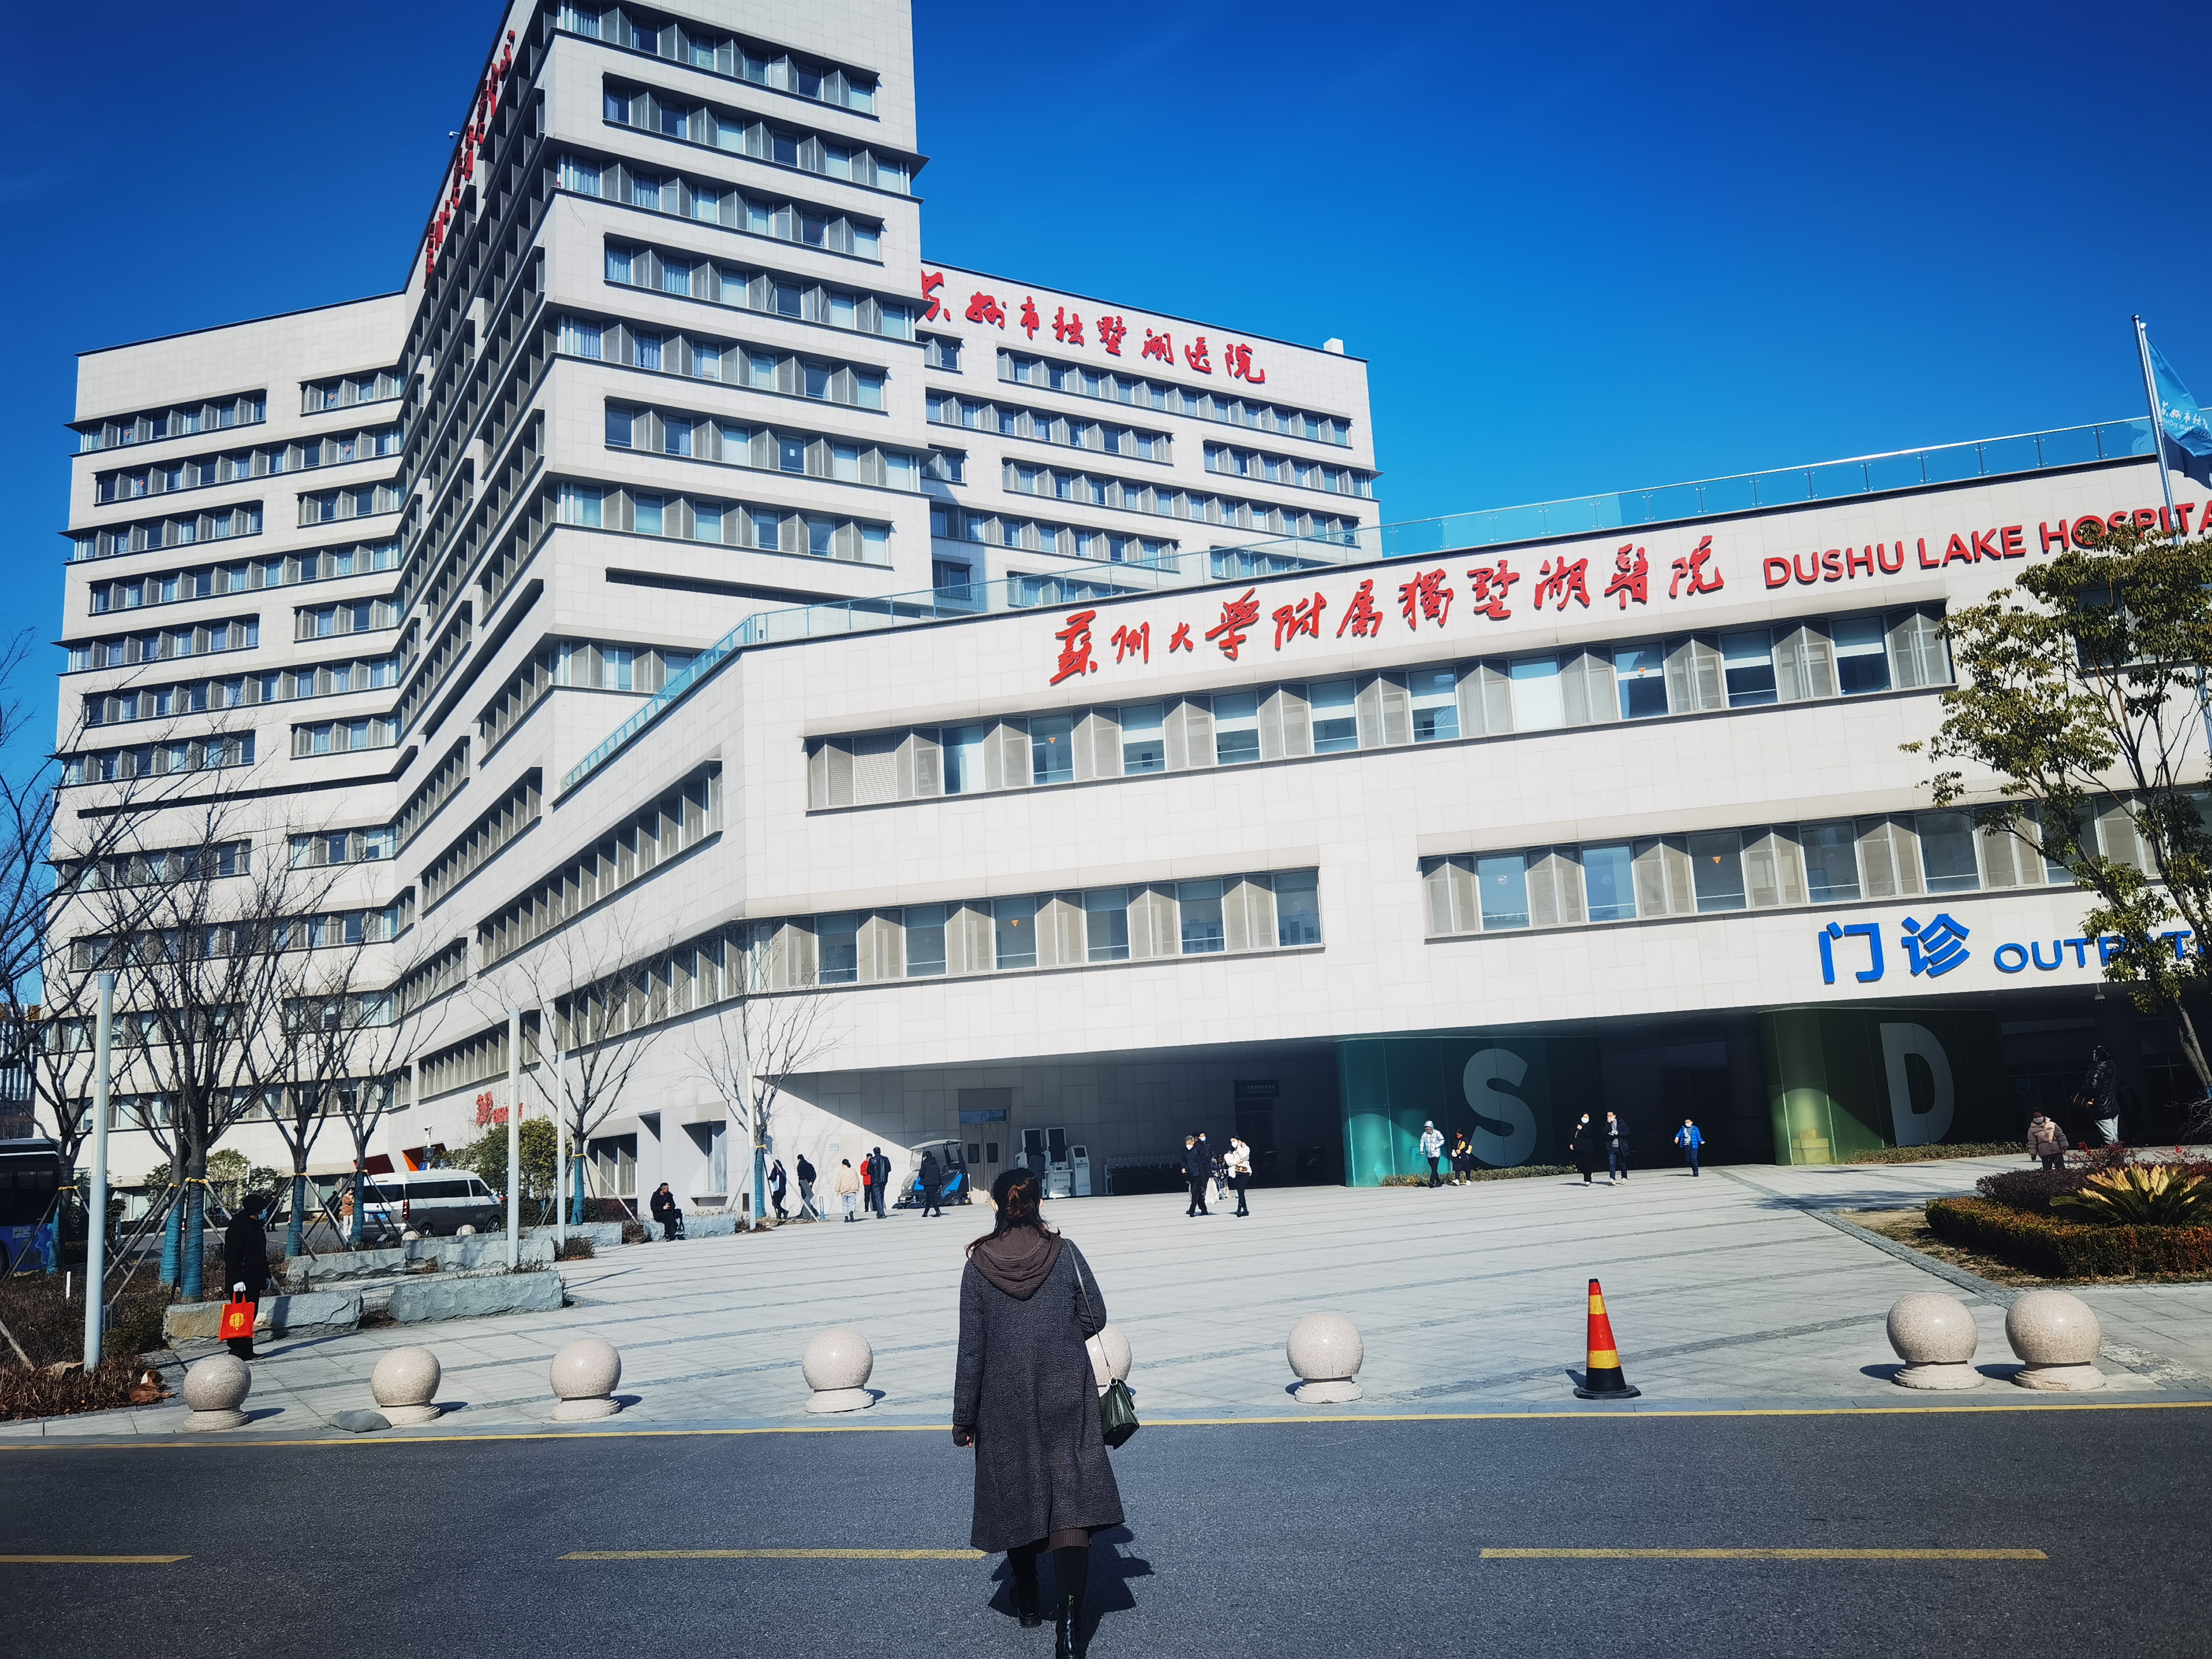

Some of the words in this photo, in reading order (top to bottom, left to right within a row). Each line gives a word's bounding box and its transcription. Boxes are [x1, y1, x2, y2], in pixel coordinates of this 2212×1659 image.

[1764, 540, 1904, 587] DUSHU
[1918, 524, 2027, 567] LAKE
[1819, 913, 1970, 983] 门诊
[1463, 1048, 1537, 1166] S
[1880, 1023, 1954, 1146] D
